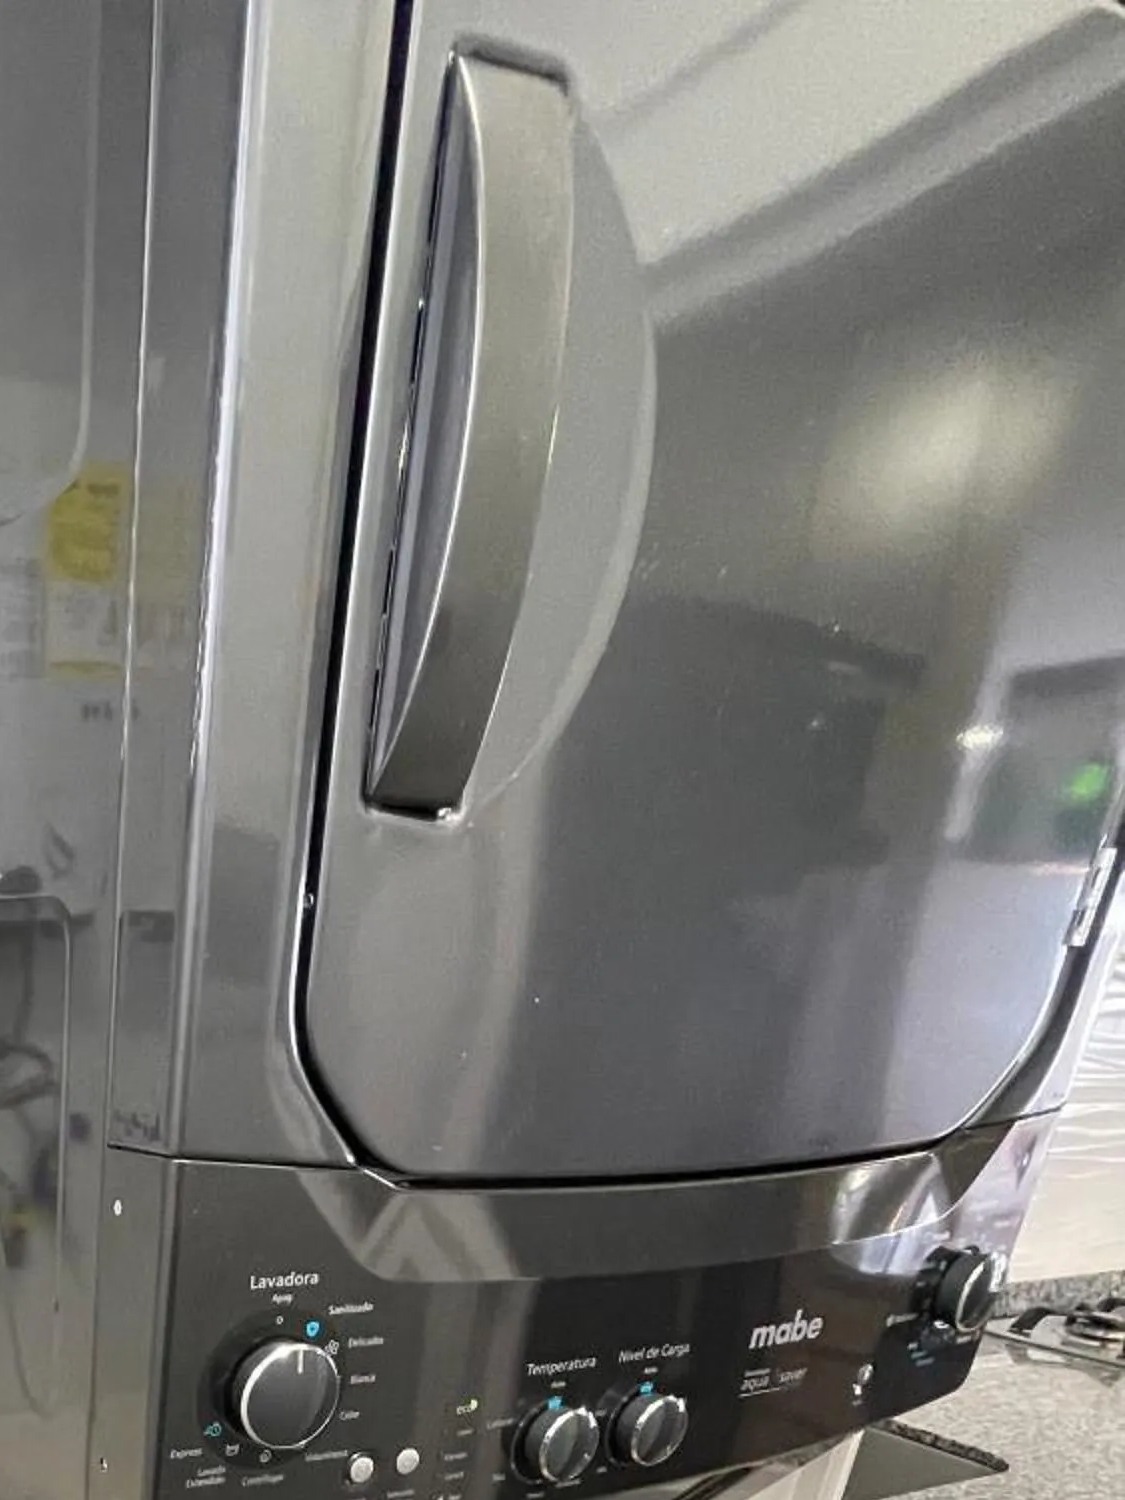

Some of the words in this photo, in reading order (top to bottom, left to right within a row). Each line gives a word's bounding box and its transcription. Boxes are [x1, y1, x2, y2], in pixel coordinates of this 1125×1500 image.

[250, 1271, 319, 1291] Lavadora
[748, 1308, 824, 1350] mabe
[618, 1351, 645, 1364] Nivel
[646, 1347, 661, 1360] de
[661, 1343, 691, 1359] Carga
[526, 1356, 598, 1376] Temperatura
